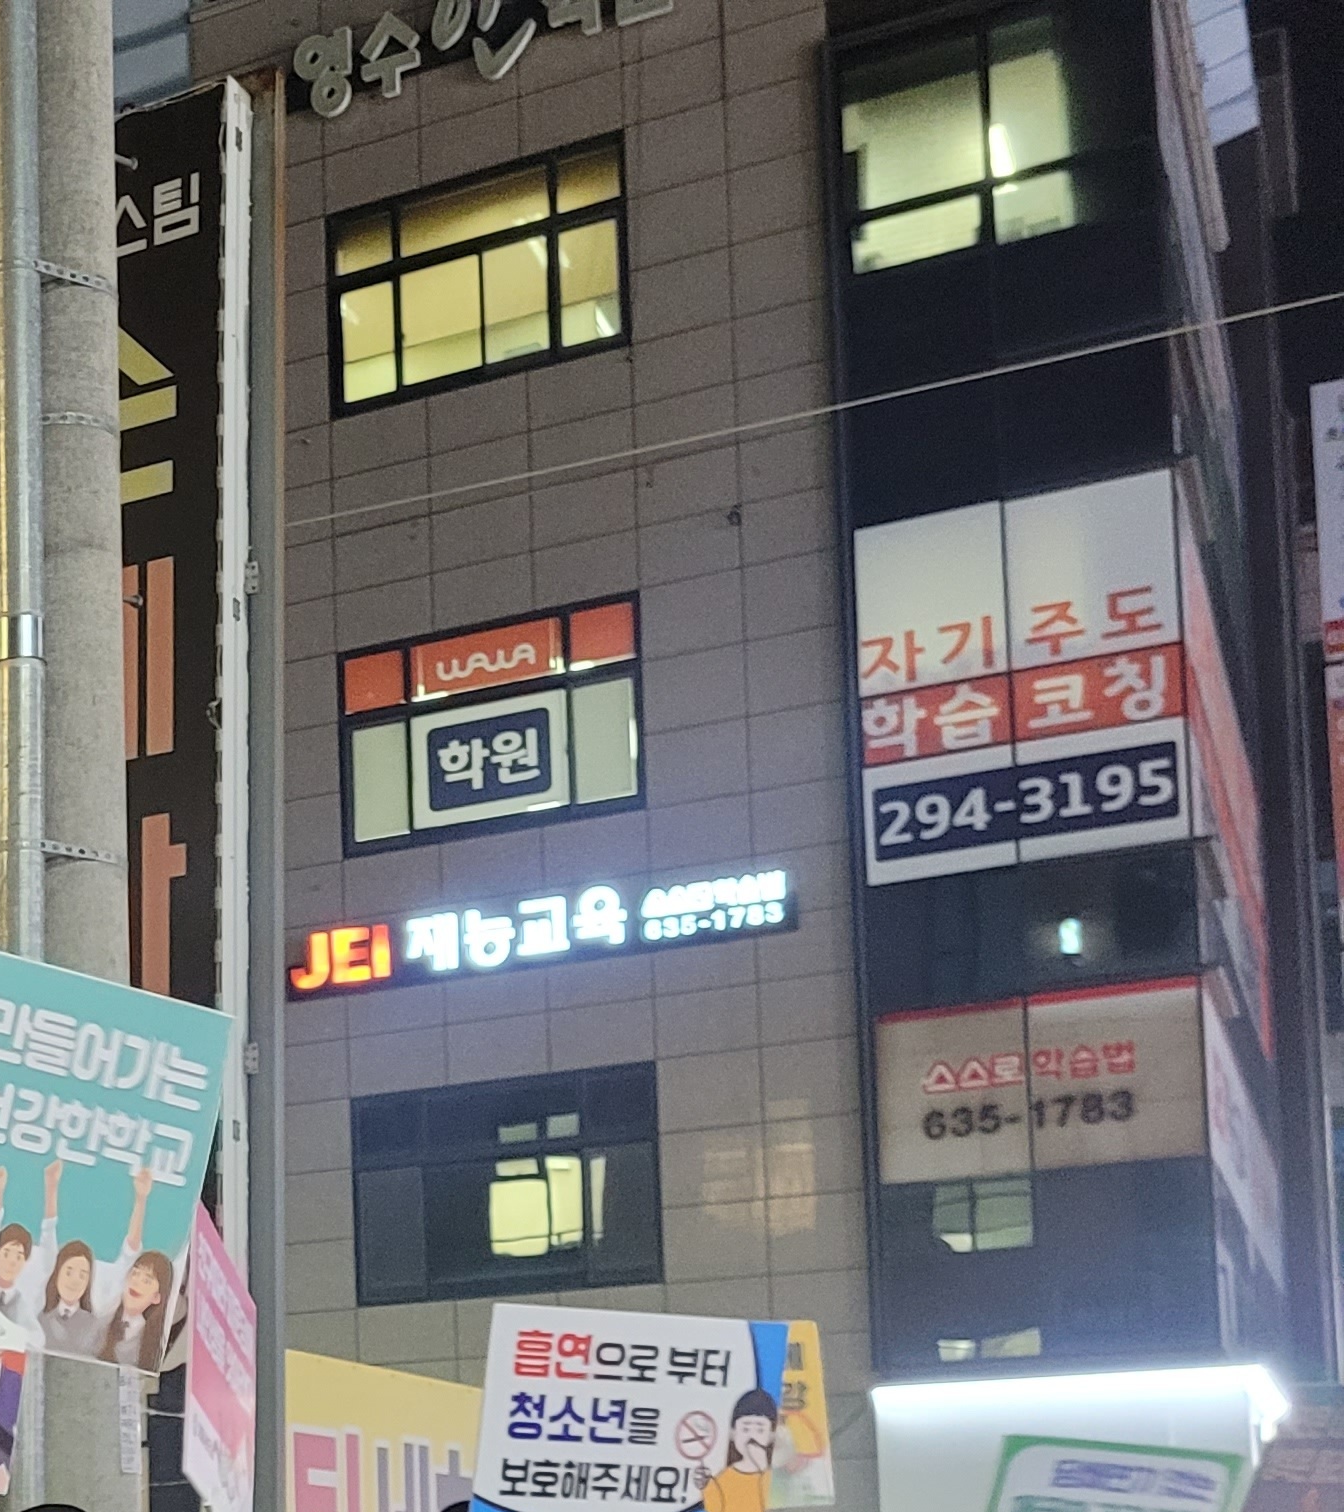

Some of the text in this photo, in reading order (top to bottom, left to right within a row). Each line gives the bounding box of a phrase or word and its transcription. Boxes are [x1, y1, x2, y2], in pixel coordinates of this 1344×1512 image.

[438, 726, 541, 791] 학원
[878, 757, 1176, 846] 294-3195
[289, 924, 392, 991] JEI
[406, 885, 628, 972] 재능교육
[643, 904, 786, 942] 635-1783
[922, 1090, 1136, 1141] 635-1783
[514, 1328, 659, 1383] 흡연으로
[668, 1347, 731, 1388] 부터
[507, 1391, 661, 1445] 청소년을
[498, 1458, 690, 1504] 보호해주세요!
